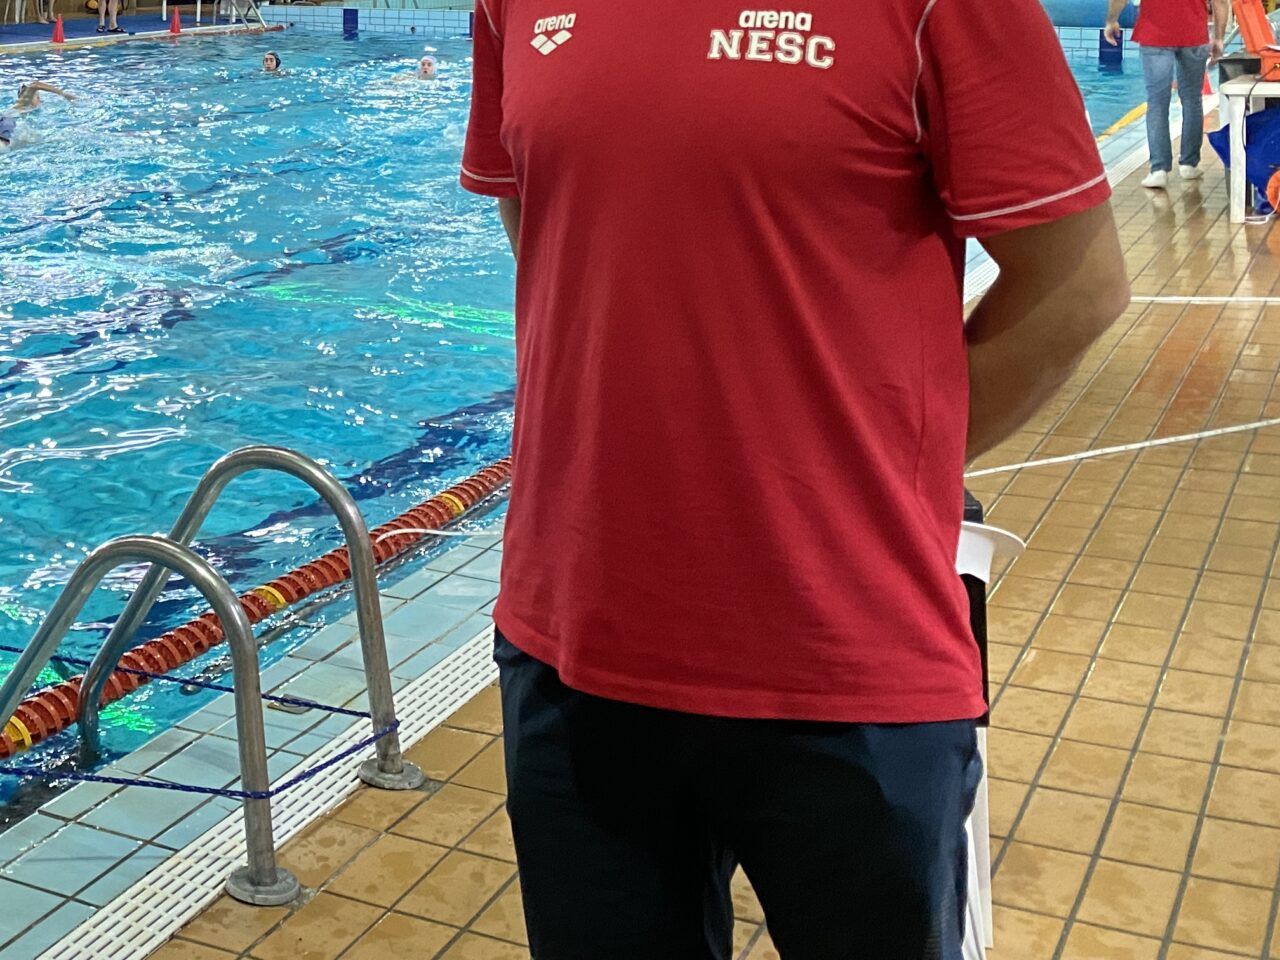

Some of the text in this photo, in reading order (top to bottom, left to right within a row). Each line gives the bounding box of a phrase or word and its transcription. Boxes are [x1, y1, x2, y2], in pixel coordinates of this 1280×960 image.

[533, 13, 577, 33] arena
[738, 9, 812, 32] arena
[707, 28, 836, 70] NESC
